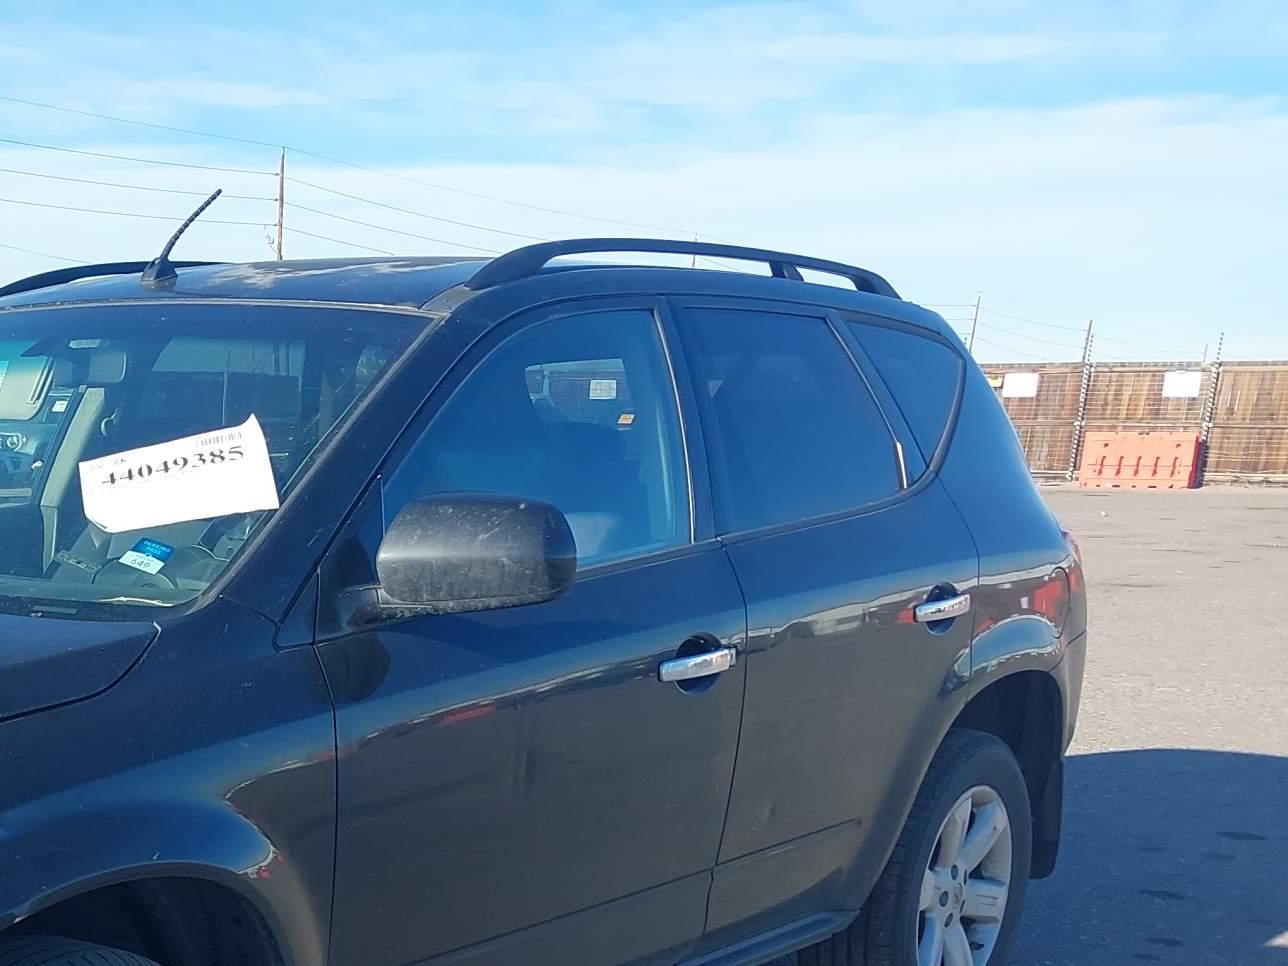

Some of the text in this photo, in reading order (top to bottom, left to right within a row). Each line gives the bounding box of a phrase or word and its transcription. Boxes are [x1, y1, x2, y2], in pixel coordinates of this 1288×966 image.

[100, 445, 245, 485] 44049385
[143, 540, 171, 553] PARKING
[130, 559, 151, 568] 649
